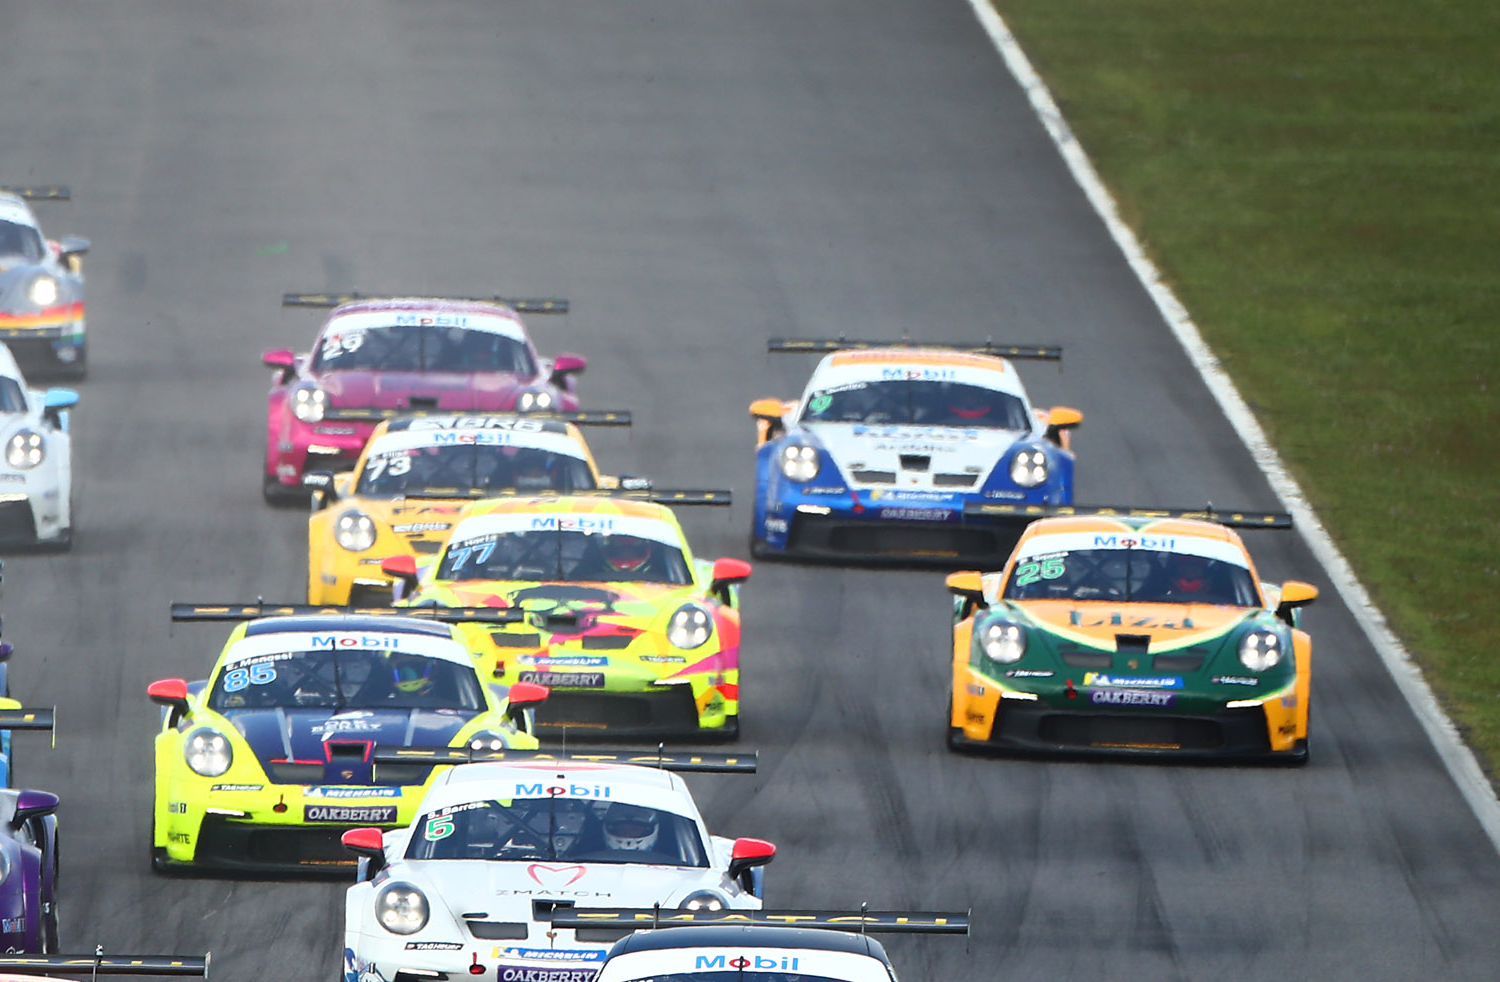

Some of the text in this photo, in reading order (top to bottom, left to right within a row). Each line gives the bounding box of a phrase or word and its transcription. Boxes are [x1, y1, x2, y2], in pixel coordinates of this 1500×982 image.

[396, 315, 466, 327] Mobil
[883, 368, 956, 380] Mobil
[435, 433, 510, 443] Mobil
[366, 456, 412, 482] 73
[532, 517, 614, 530] Mobil
[1094, 536, 1175, 549] Mobil
[448, 542, 497, 572] 77
[1015, 558, 1066, 587] 25
[312, 636, 399, 649] Mobil
[223, 661, 277, 693] 85
[523, 674, 600, 686] OAKBERRY
[1092, 690, 1172, 706] OAKBERRY
[515, 783, 610, 798] Mobil
[308, 807, 393, 821] OAKBERRY
[424, 814, 456, 842] 5
[496, 889, 611, 898] ZMATCH
[523, 949, 599, 960] MICHELIN
[695, 954, 799, 971] Mobil
